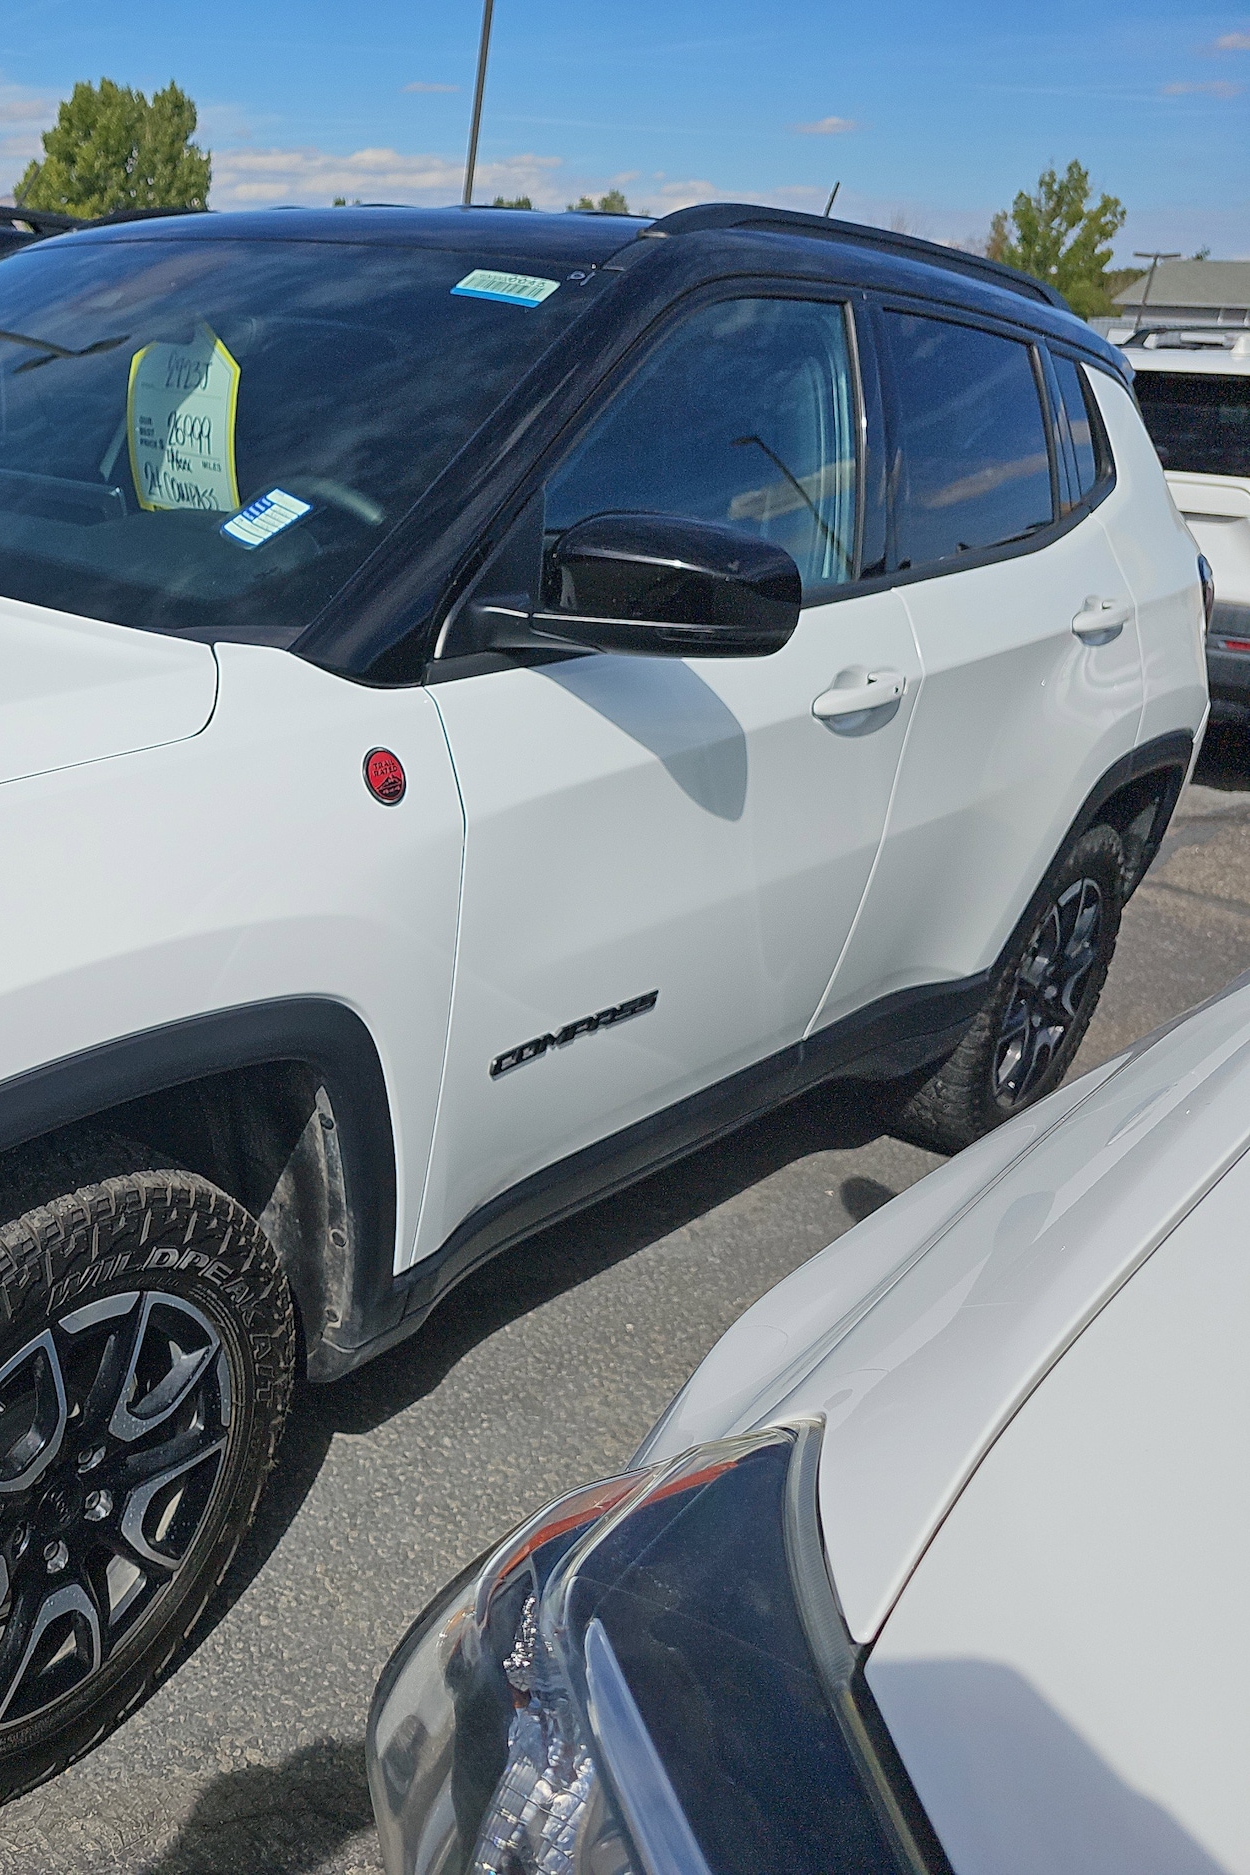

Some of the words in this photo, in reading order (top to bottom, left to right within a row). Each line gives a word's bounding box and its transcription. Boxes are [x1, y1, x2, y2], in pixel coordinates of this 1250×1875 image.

[167, 410, 212, 455] 26999
[163, 471, 219, 510] COMPASS
[373, 765, 398, 777] RATED
[489, 989, 659, 1081] COMPASS
[45, 1246, 261, 1328] WILDPEAK
